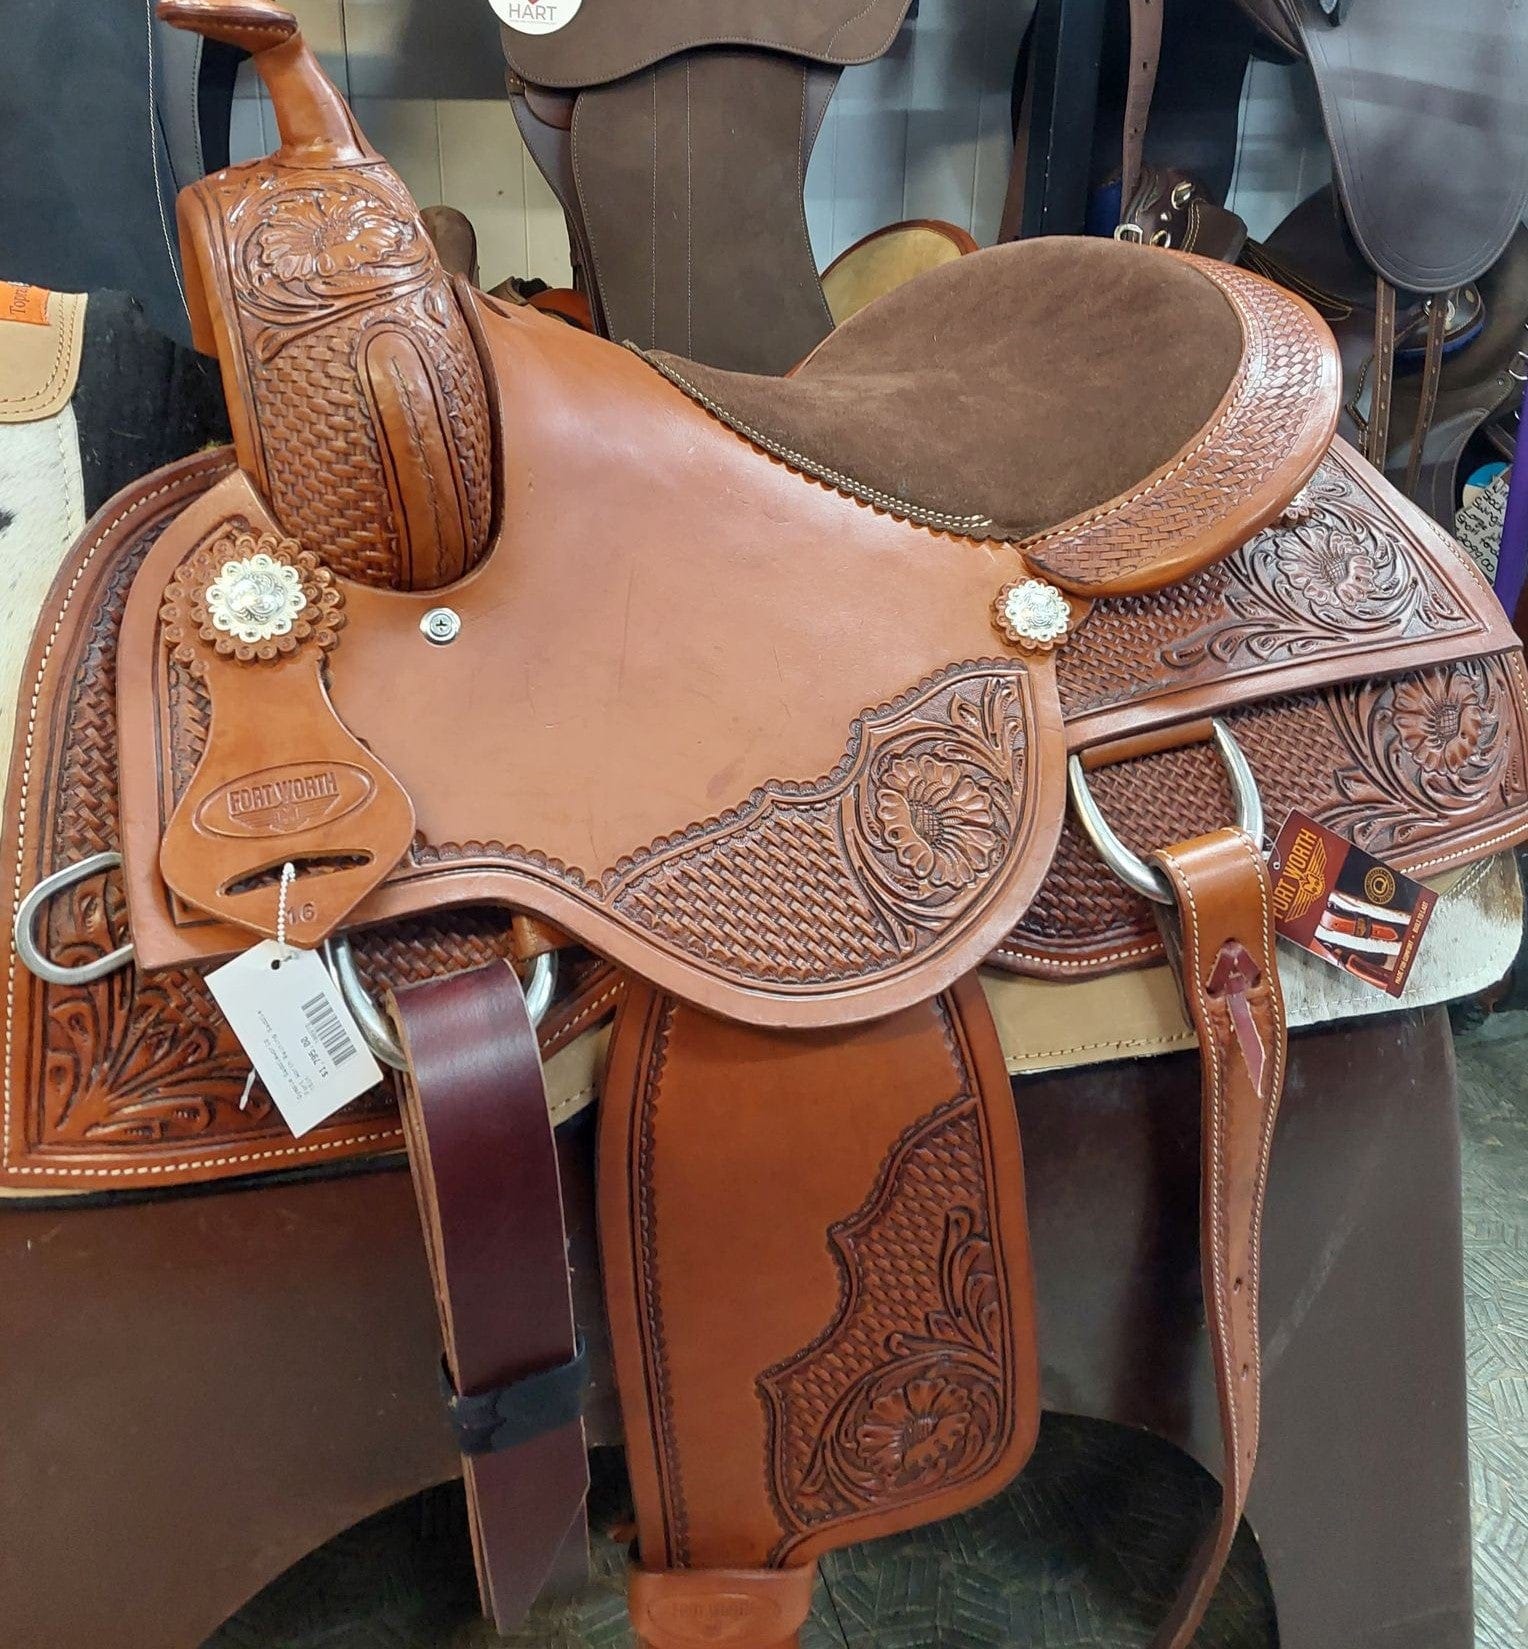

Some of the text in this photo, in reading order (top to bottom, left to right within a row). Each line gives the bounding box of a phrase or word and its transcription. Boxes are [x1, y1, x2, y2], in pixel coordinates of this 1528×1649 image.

[509, 3, 557, 20] HART
[228, 771, 338, 814] FORT WORTH
[1282, 827, 1317, 878] WORTH
[285, 901, 317, 924] 16
